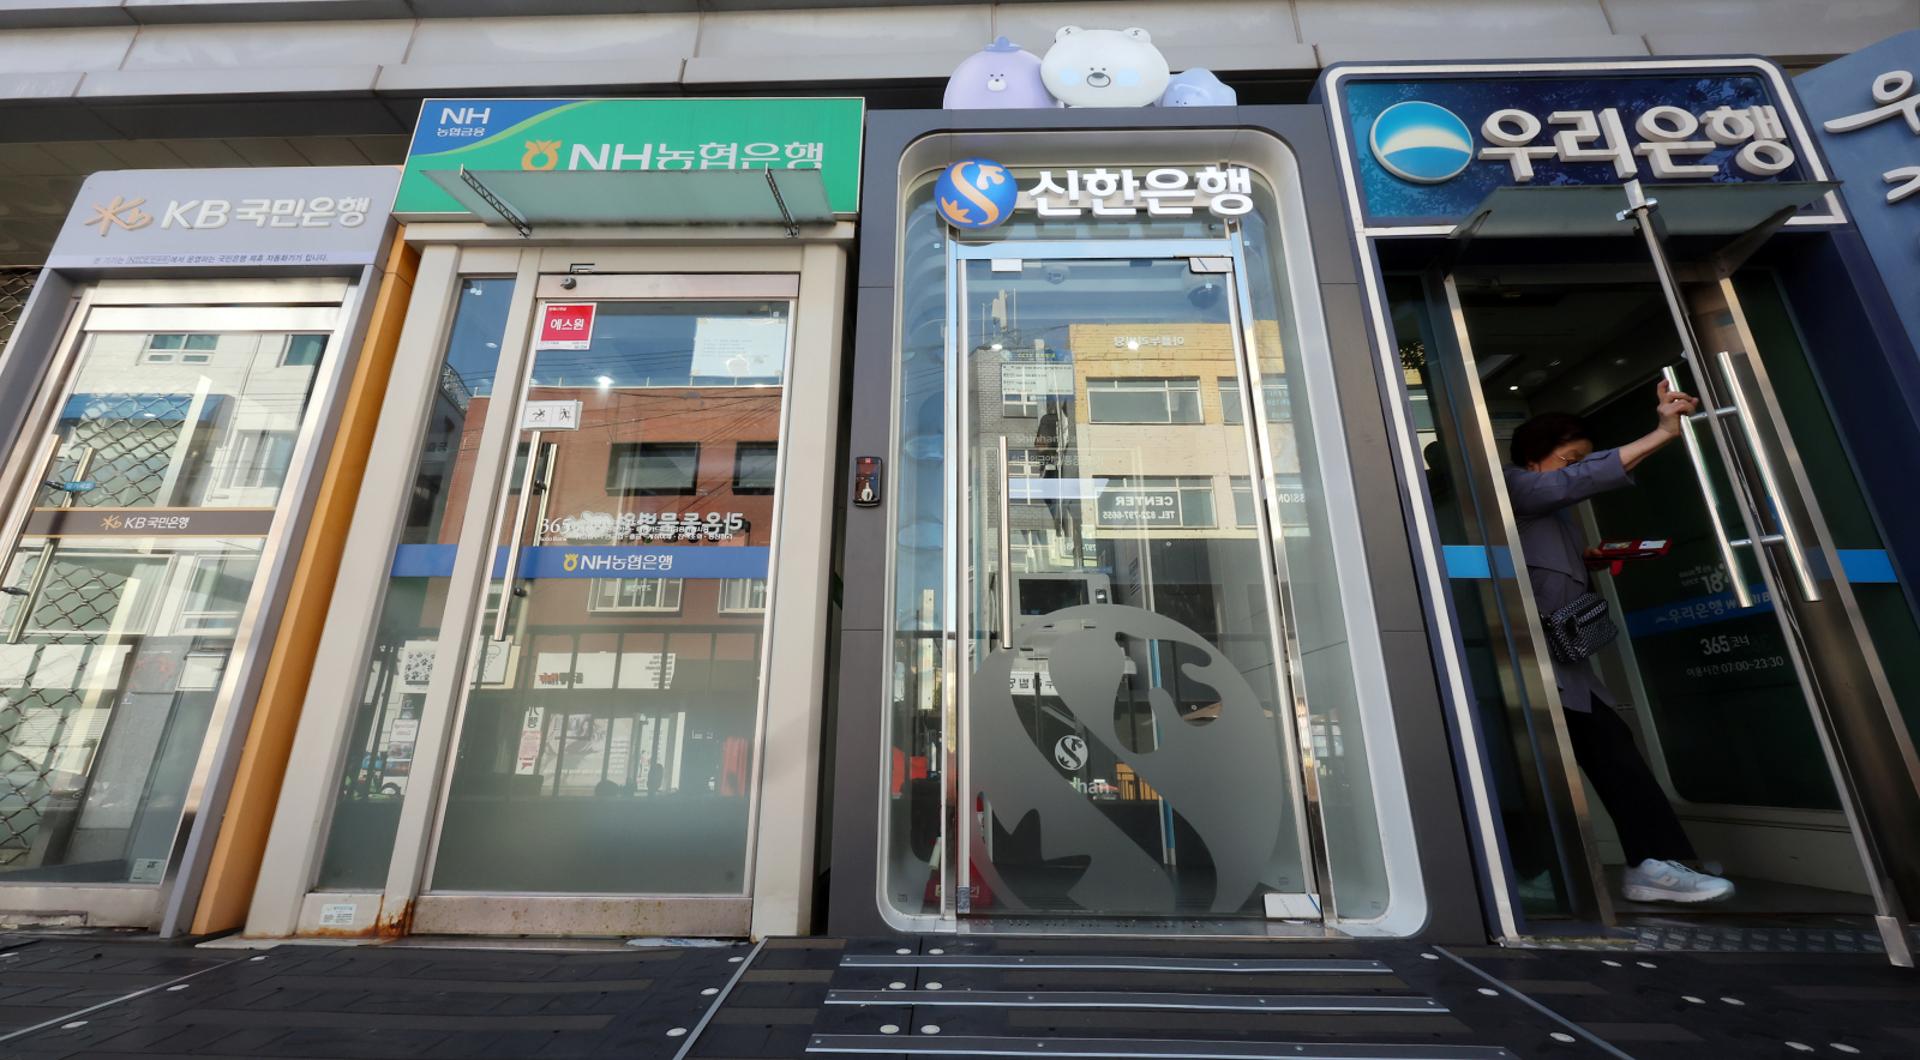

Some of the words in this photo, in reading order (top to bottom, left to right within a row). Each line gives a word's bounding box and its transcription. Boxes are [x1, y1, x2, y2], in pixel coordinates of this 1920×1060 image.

[440, 107, 491, 124] NH
[436, 127, 487, 137] 농협금융
[1477, 105, 1795, 183] 우리은행
[568, 142, 824, 171] NH농협은행
[1029, 166, 1254, 218] 신한은행
[217, 255, 247, 263] 국민은행
[550, 318, 584, 331] 에스원
[580, 554, 673, 571] NH농협은행
[1668, 599, 1725, 625] 우리은행
[1699, 635, 1731, 656] 365
[1730, 634, 1751, 648] 코너
